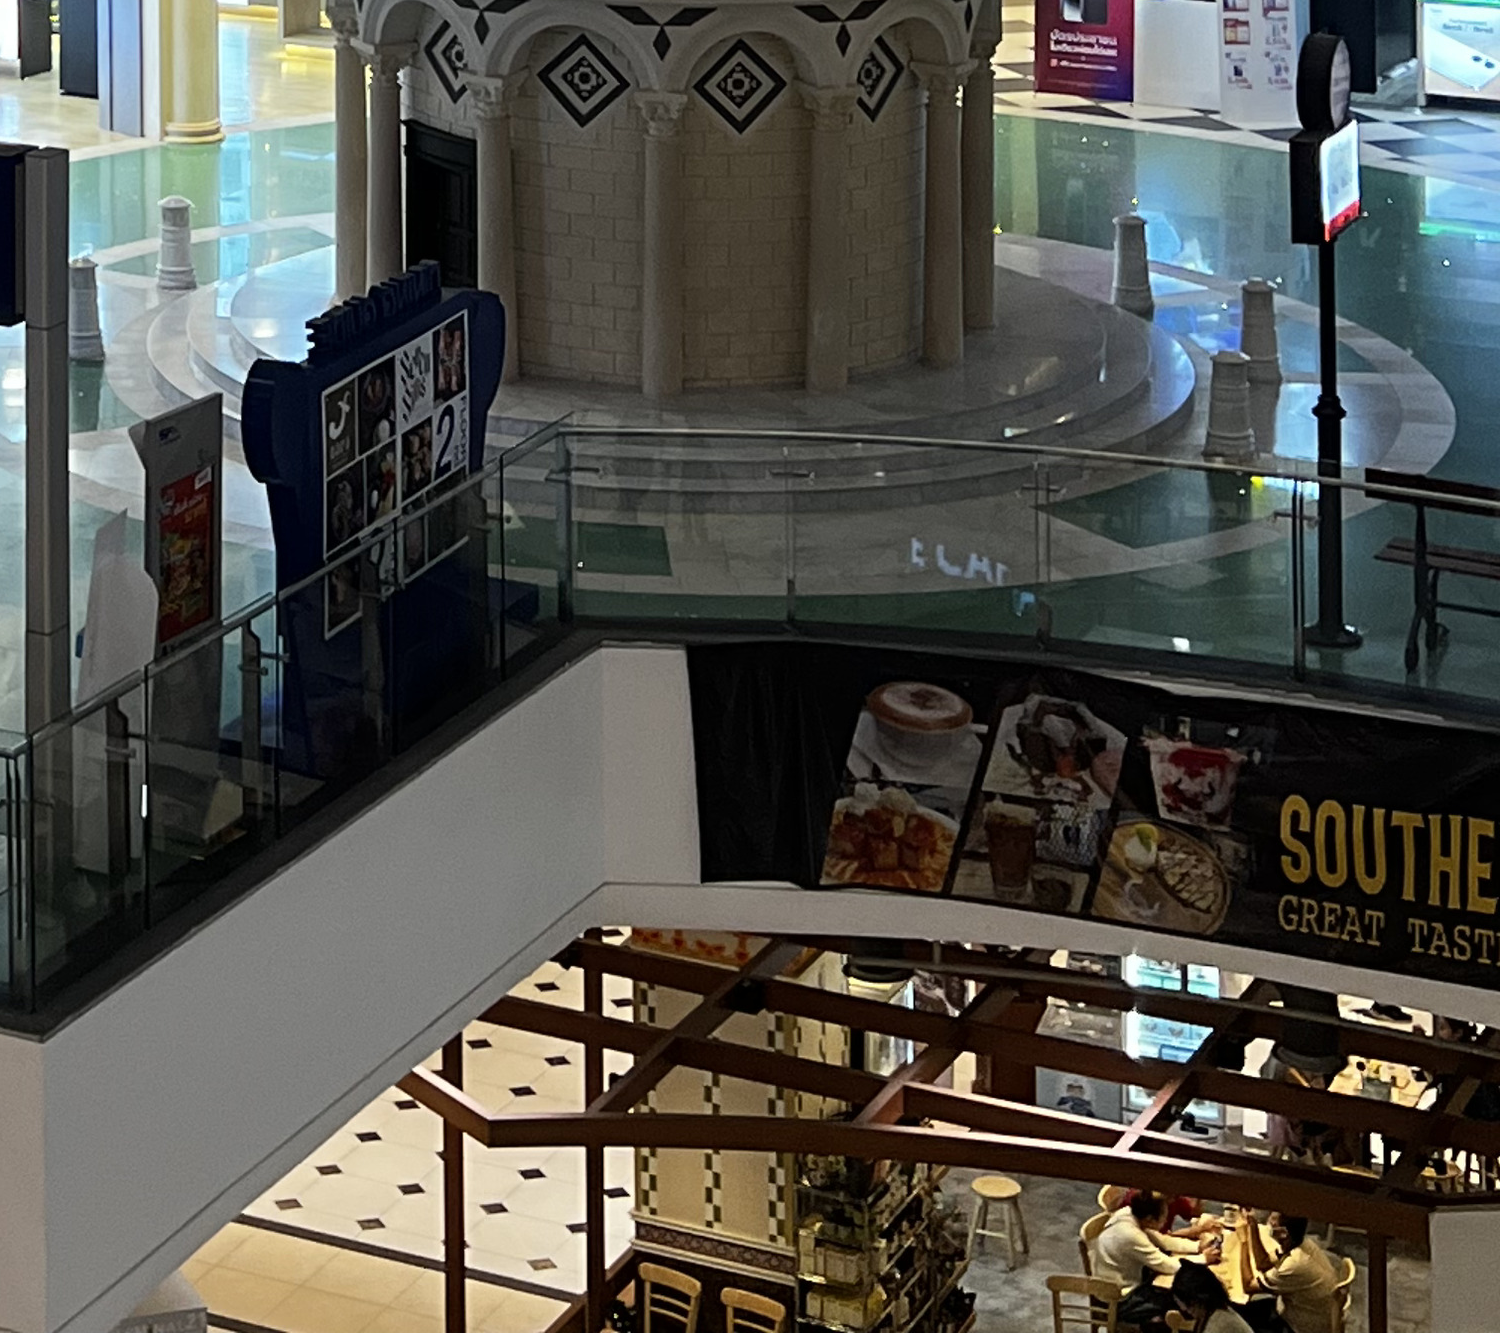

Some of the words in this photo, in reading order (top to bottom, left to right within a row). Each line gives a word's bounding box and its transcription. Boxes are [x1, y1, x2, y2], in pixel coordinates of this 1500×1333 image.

[434, 401, 455, 482] 2
[1279, 794, 1499, 915] SOUTHE
[1277, 894, 1386, 947] GREAT
[1407, 917, 1500, 968] TAST
